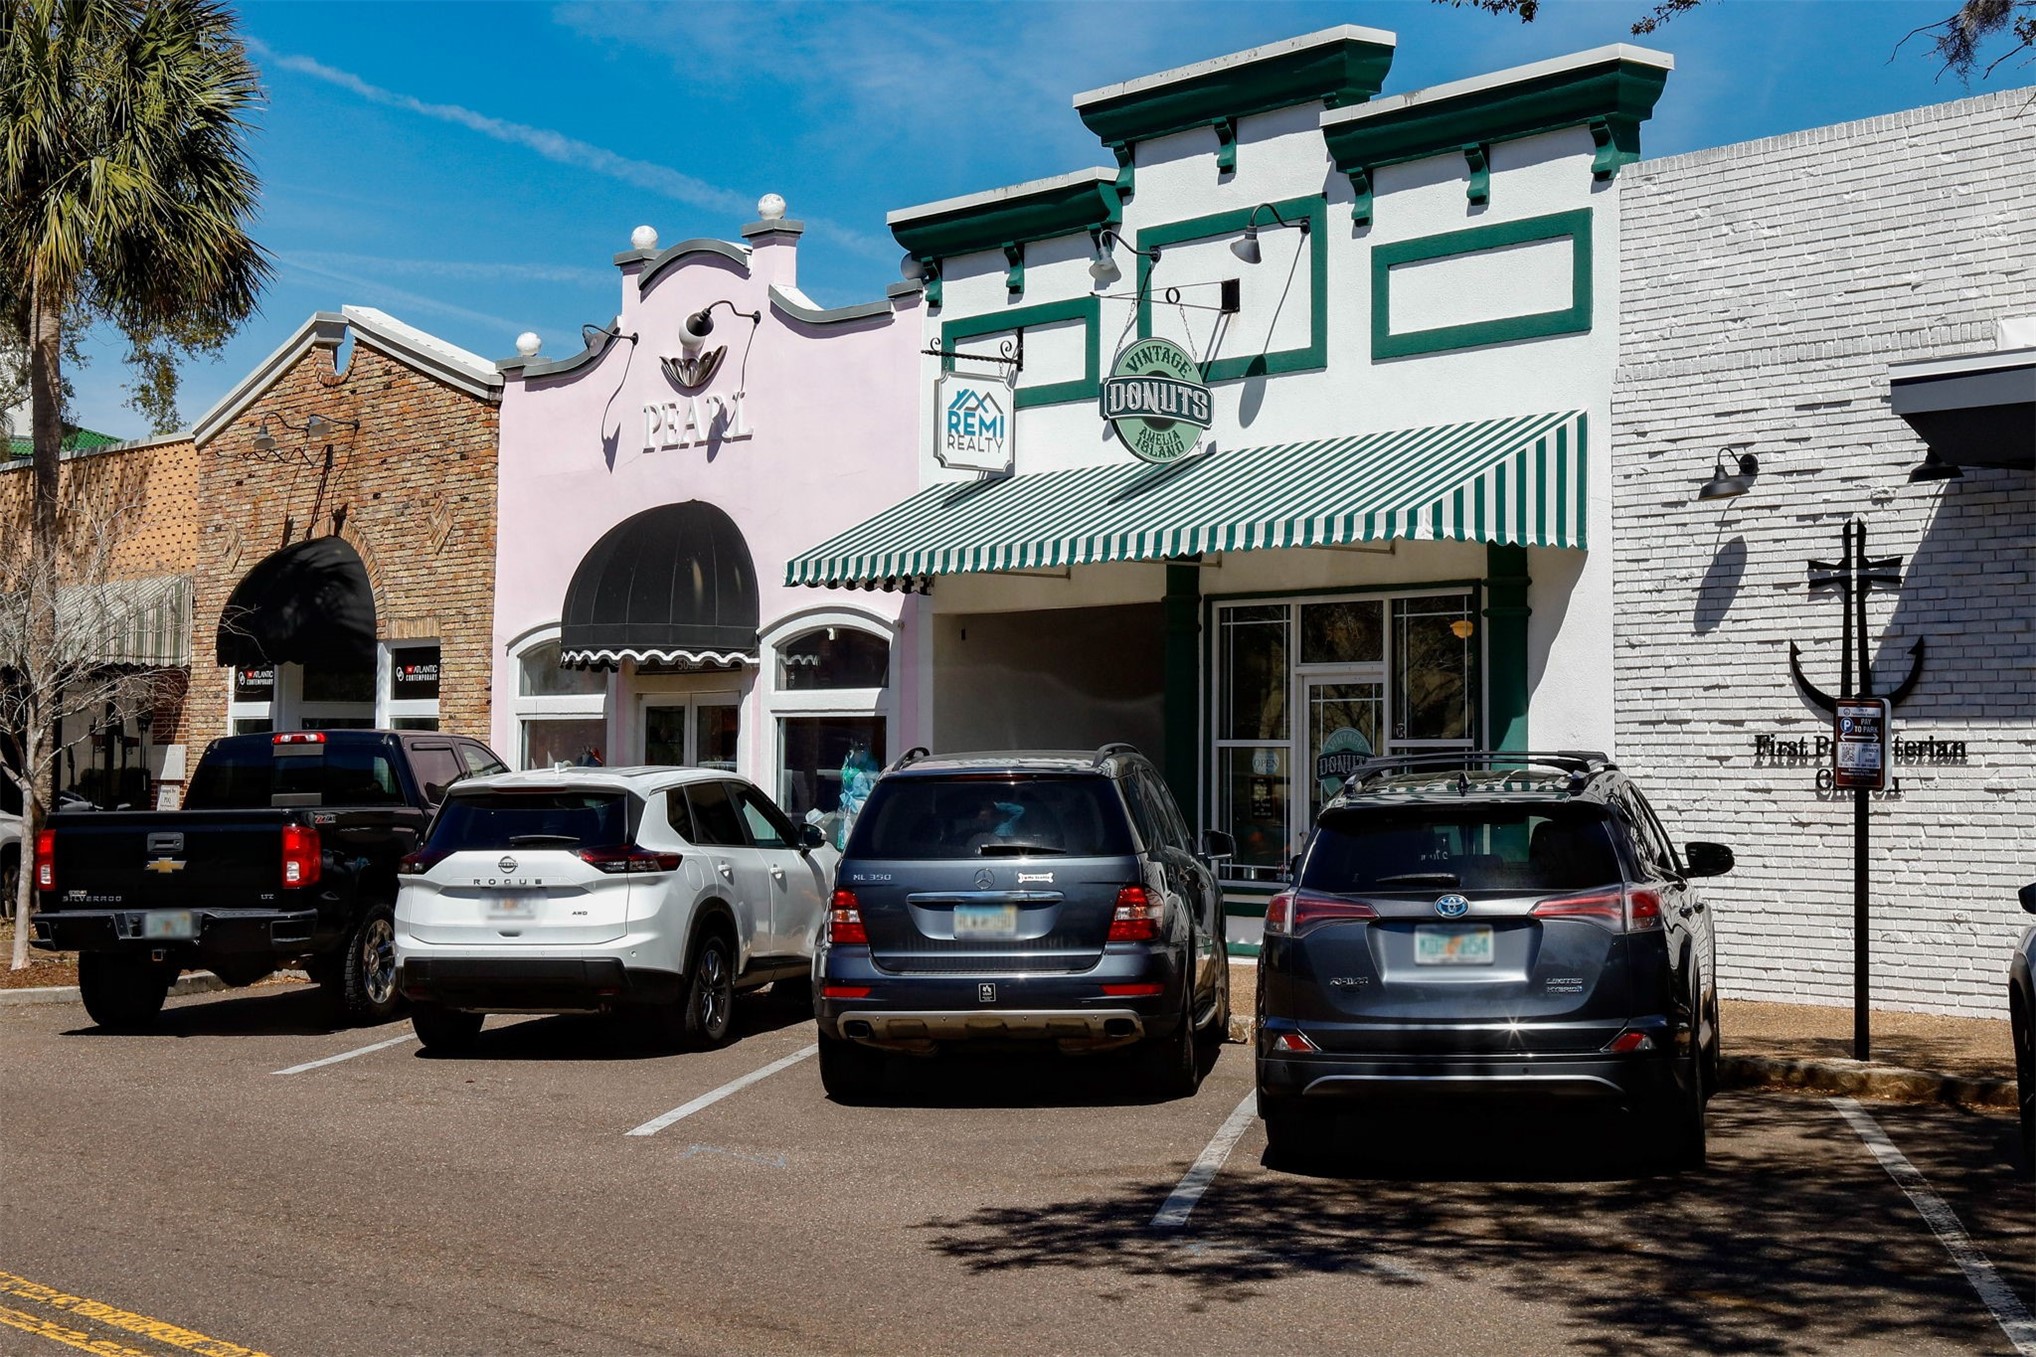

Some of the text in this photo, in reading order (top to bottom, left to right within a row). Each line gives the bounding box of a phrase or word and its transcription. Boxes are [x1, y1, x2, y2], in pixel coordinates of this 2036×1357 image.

[1125, 345, 1193, 379] VINTAGE
[1109, 381, 1209, 421] DONUTS
[642, 392, 754, 453] PEARL
[947, 410, 1005, 439] REMI
[947, 433, 1004, 454] REALTY
[1138, 425, 1181, 446] AMELIA
[1134, 437, 1186, 459] ISLAND
[1843, 719, 1851, 731] P
[1854, 725, 1879, 733] TO PARK
[1860, 718, 1872, 726] PAY
[1754, 733, 1968, 758] First Pterian
[1253, 759, 1279, 768] OPEN
[1319, 754, 1367, 776] DONUT
[473, 878, 543, 886] ROGUE
